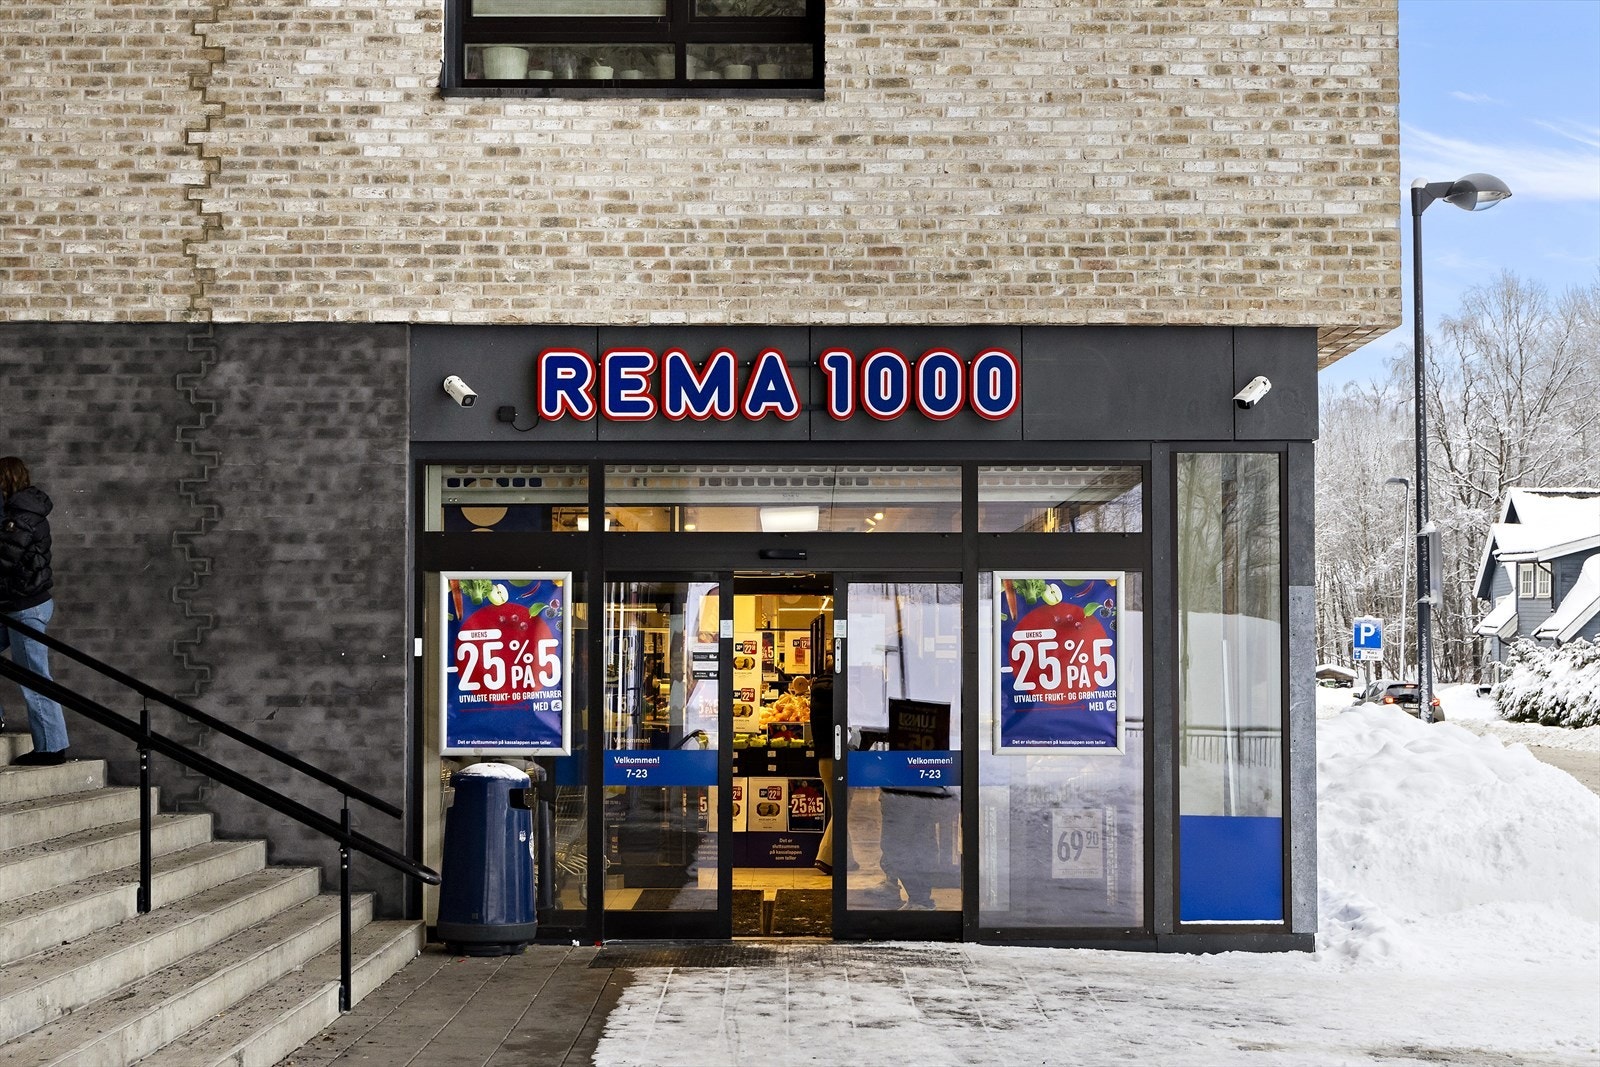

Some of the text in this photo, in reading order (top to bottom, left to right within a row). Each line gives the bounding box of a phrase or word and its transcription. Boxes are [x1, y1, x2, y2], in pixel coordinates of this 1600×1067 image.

[538, 348, 1020, 421] REMA 1000
[1360, 623, 1375, 645] P
[511, 665, 536, 689] PÅ
[538, 638, 561, 687] 5
[1067, 665, 1091, 689] PÅ
[1093, 638, 1116, 687] 5
[459, 690, 562, 703] UTVALGTE FRUKT- OG GRØNTVARER
[1014, 690, 1116, 703] UTVALGTE FRUKT- OG GRØNTVARER
[533, 702, 548, 711] MED
[1089, 702, 1104, 711] MED
[614, 756, 660, 764] Velkommen!
[907, 757, 953, 765] Velkommen!
[626, 769, 648, 778] 7-23
[919, 769, 941, 779] 7-23
[817, 797, 823, 812] 5
[1057, 830, 1099, 862] 69 90
